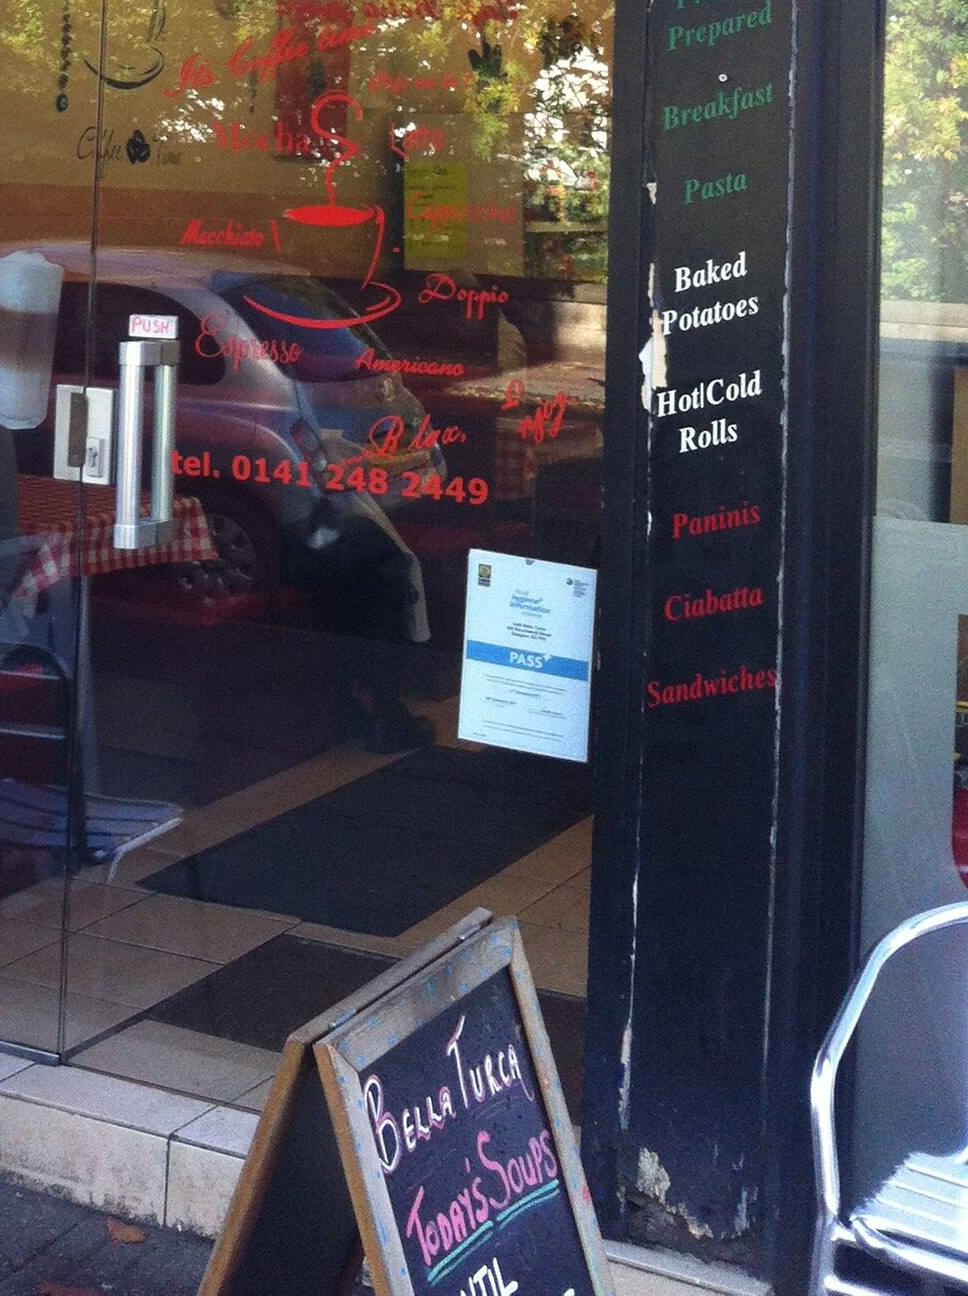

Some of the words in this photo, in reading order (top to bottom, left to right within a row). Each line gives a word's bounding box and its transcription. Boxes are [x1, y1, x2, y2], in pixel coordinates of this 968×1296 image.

[667, 1, 773, 53] Prepared
[662, 82, 774, 132] Breakfast
[683, 170, 748, 204] Pasta
[674, 251, 748, 292] Baked
[418, 273, 510, 320] Doppio
[662, 296, 759, 336] Potatoes
[131, 317, 170, 334] PUSH
[356, 348, 465, 377] Americano
[679, 418, 738, 453] Rolls
[171, 451, 221, 478] tel.
[233, 455, 311, 488] 0141
[326, 464, 389, 495] 248
[401, 471, 489, 505] 2449
[671, 501, 760, 539] Paninis
[664, 582, 764, 622] Ciabatta
[509, 651, 544, 669] PASS
[646, 664, 778, 708] Sandwiches
